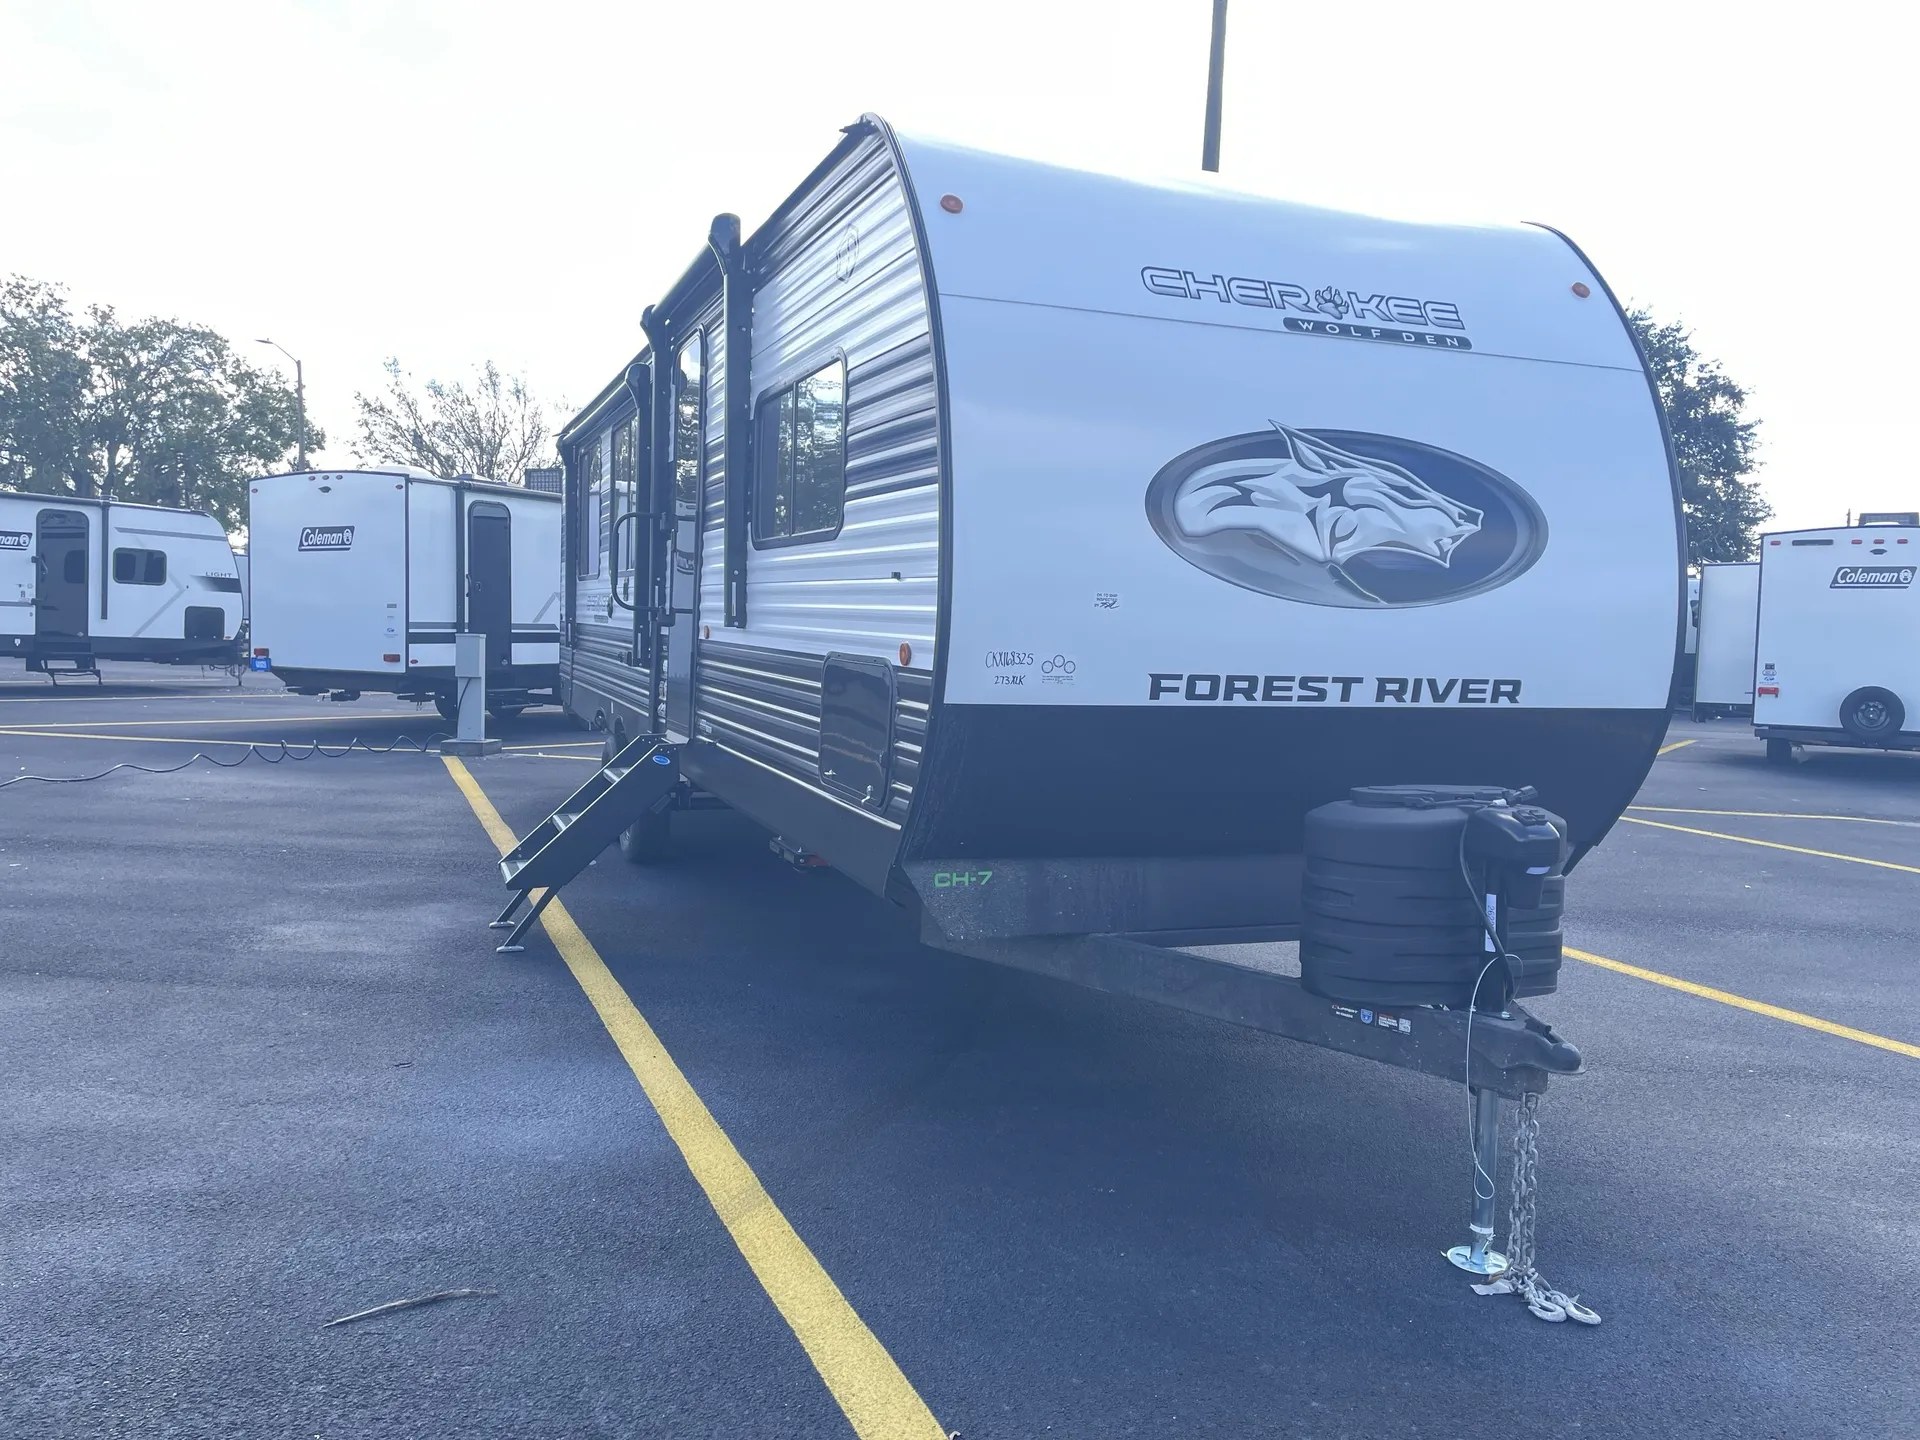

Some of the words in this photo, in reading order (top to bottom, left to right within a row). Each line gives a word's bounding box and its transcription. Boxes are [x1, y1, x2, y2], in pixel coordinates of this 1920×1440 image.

[1140, 265, 1466, 331] CHEROKEE
[1297, 319, 1382, 340] WOLF
[1401, 331, 1461, 348] DEN
[302, 528, 343, 547] Coleman
[1837, 567, 1899, 584] Coleman
[1147, 673, 1364, 703] FOREST
[1374, 677, 1523, 704] RIVER
[934, 870, 993, 888] CH-7
